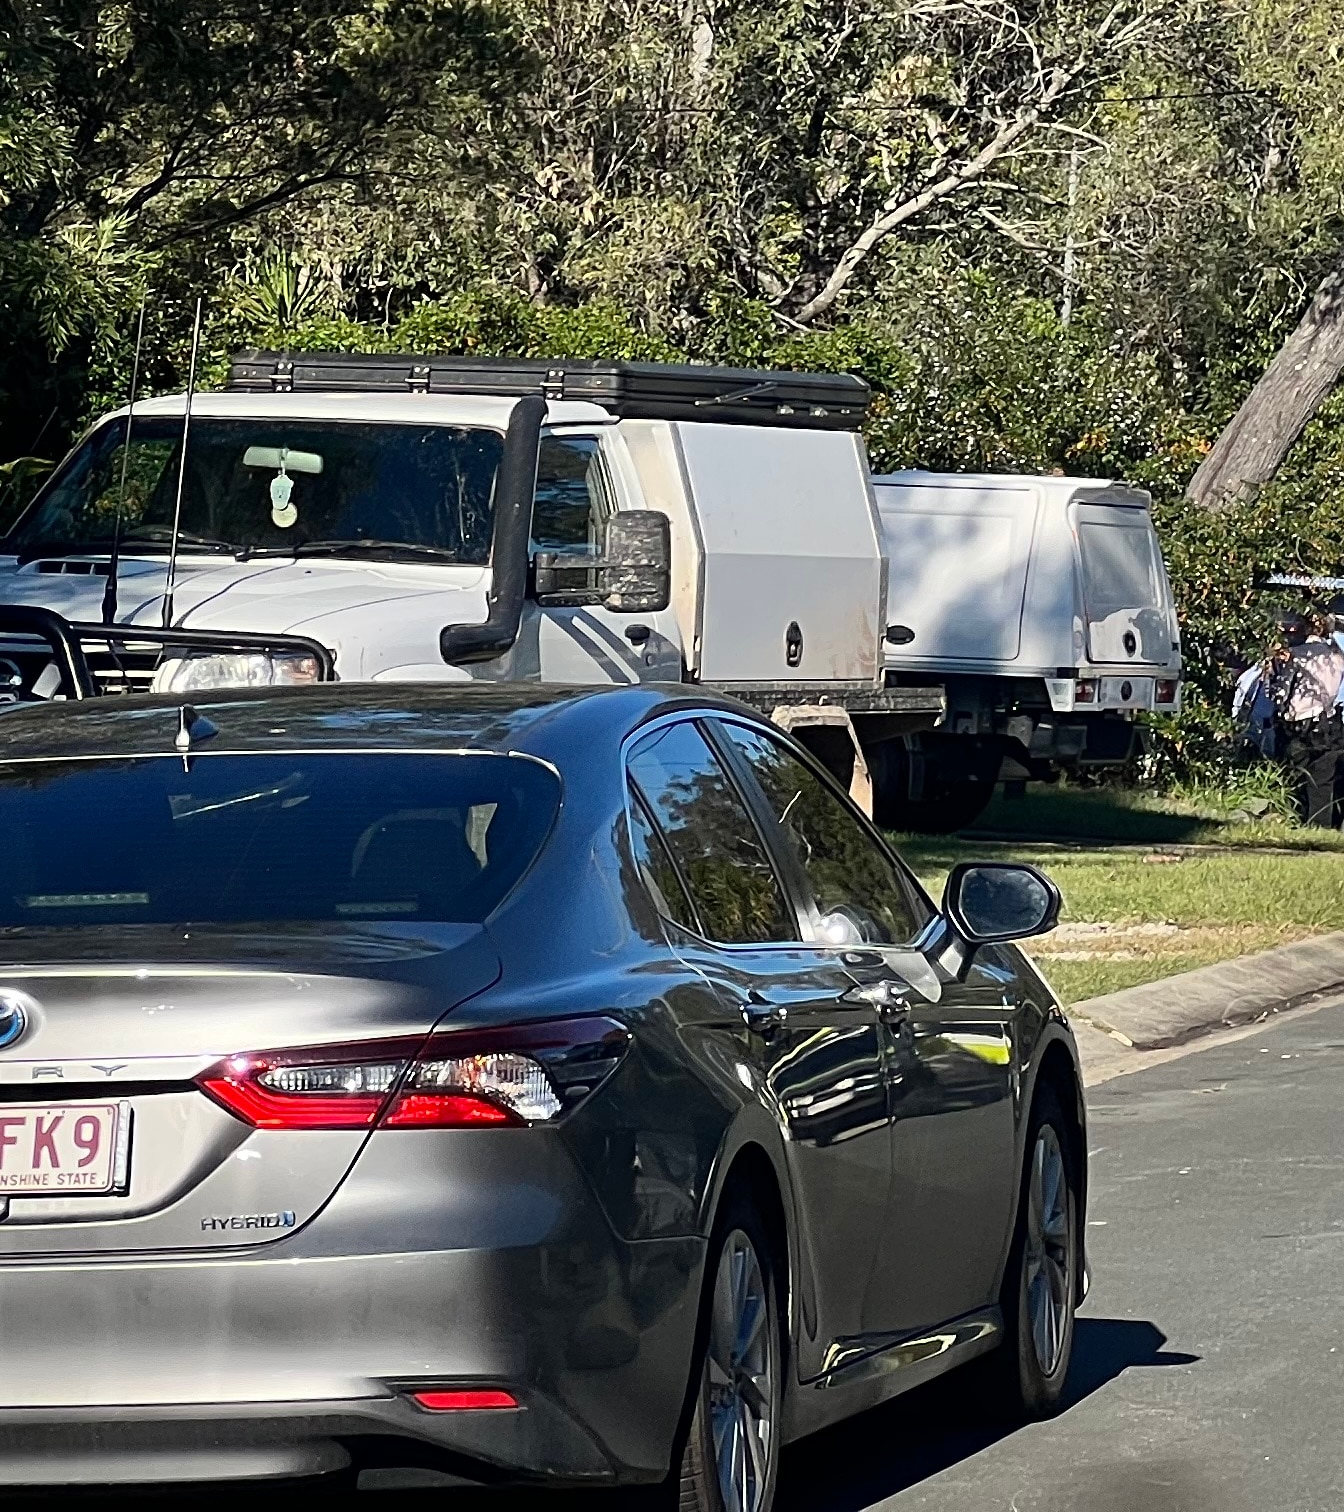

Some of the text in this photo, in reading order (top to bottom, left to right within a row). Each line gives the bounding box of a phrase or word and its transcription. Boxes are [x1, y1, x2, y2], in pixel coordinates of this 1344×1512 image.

[0, 1115, 101, 1169] FK9
[57, 1172, 98, 1186] STATE
[200, 1215, 280, 1231] HYBRID
